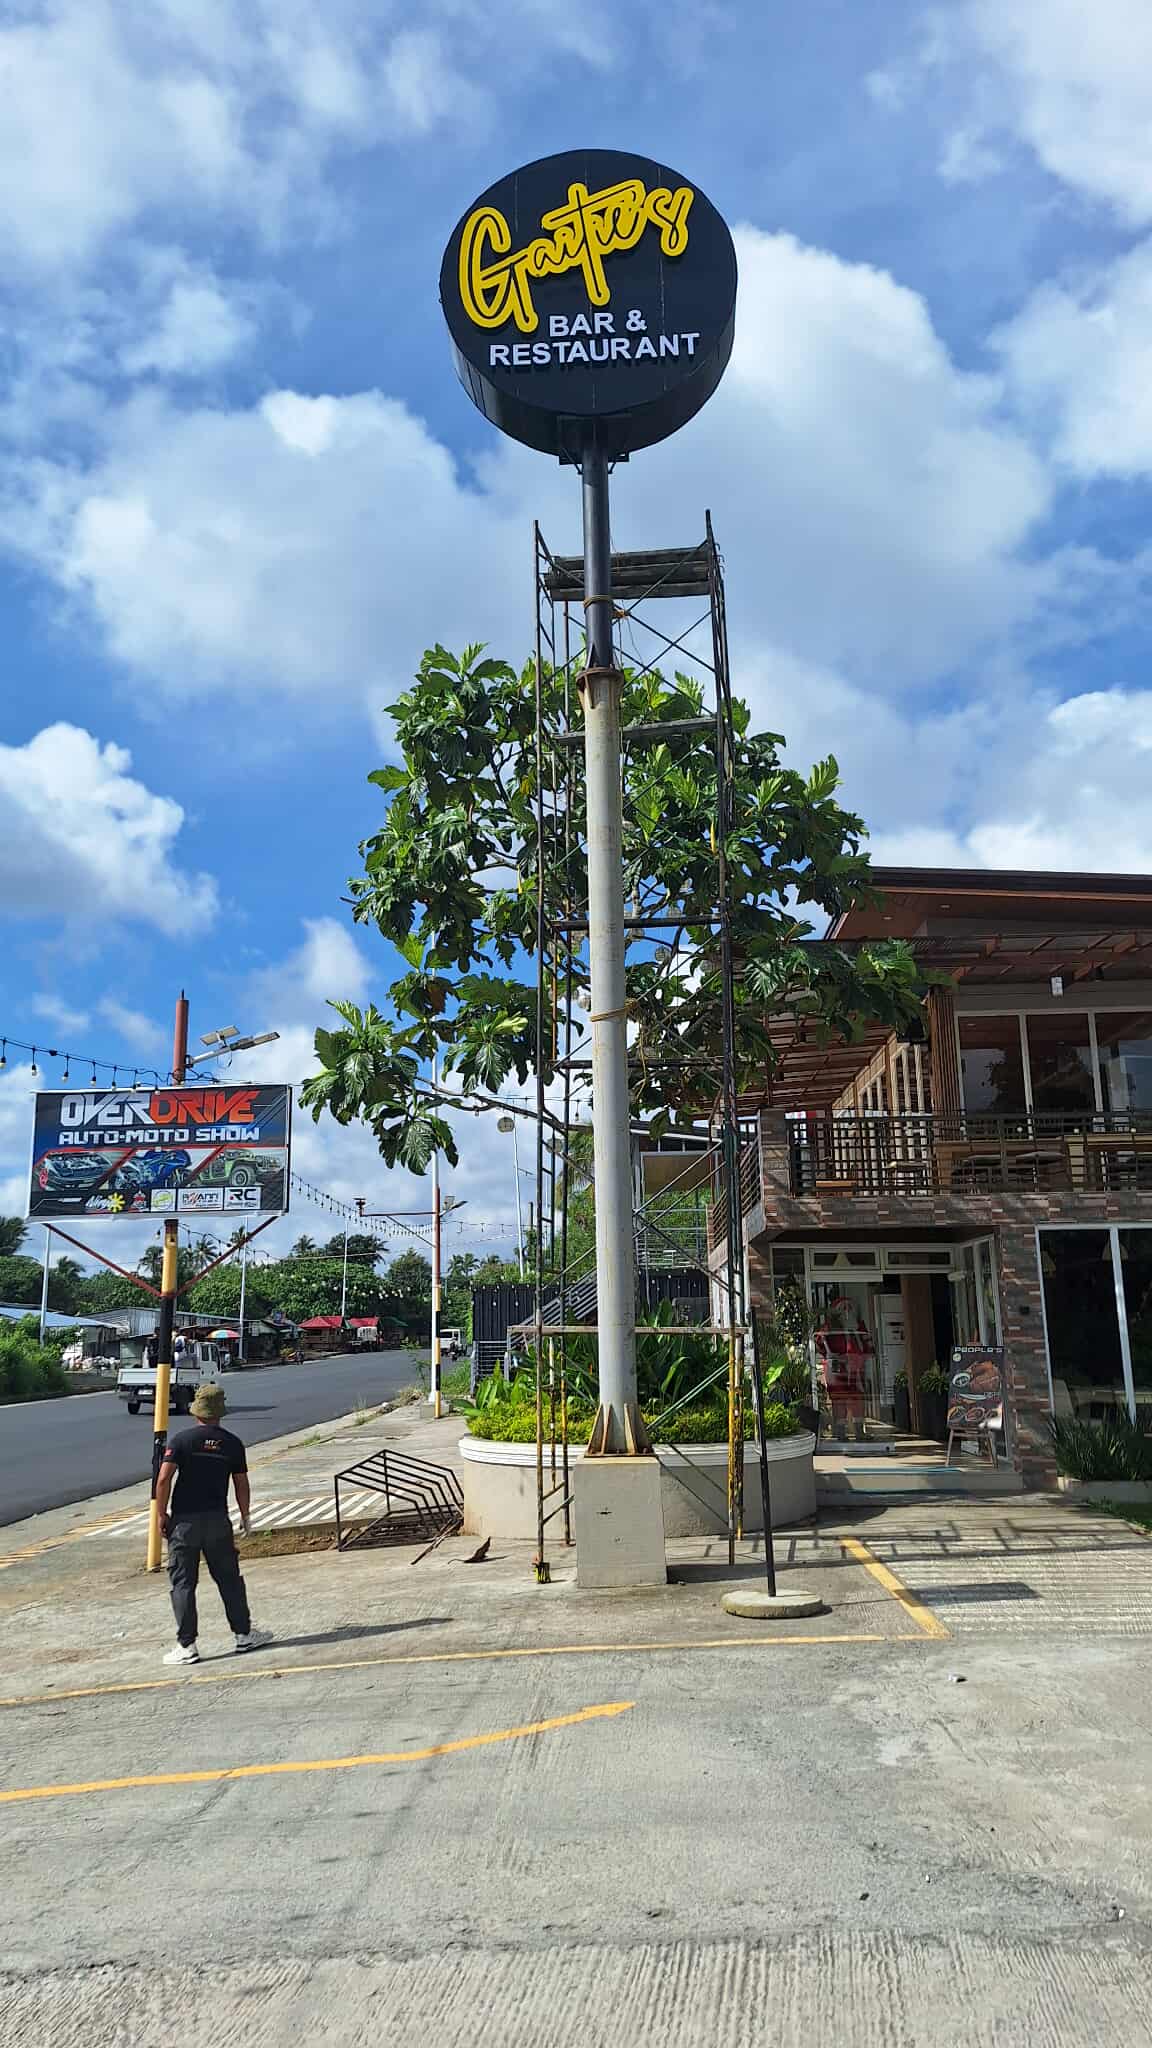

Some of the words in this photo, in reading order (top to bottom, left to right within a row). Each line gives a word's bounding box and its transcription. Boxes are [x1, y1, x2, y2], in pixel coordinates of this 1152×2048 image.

[549, 312, 616, 337] BAR
[625, 309, 648, 332] &
[489, 333, 700, 366] RESTAURANT
[59, 1128, 190, 1145] AUTO-MOTO
[195, 1127, 261, 1142] SHOW
